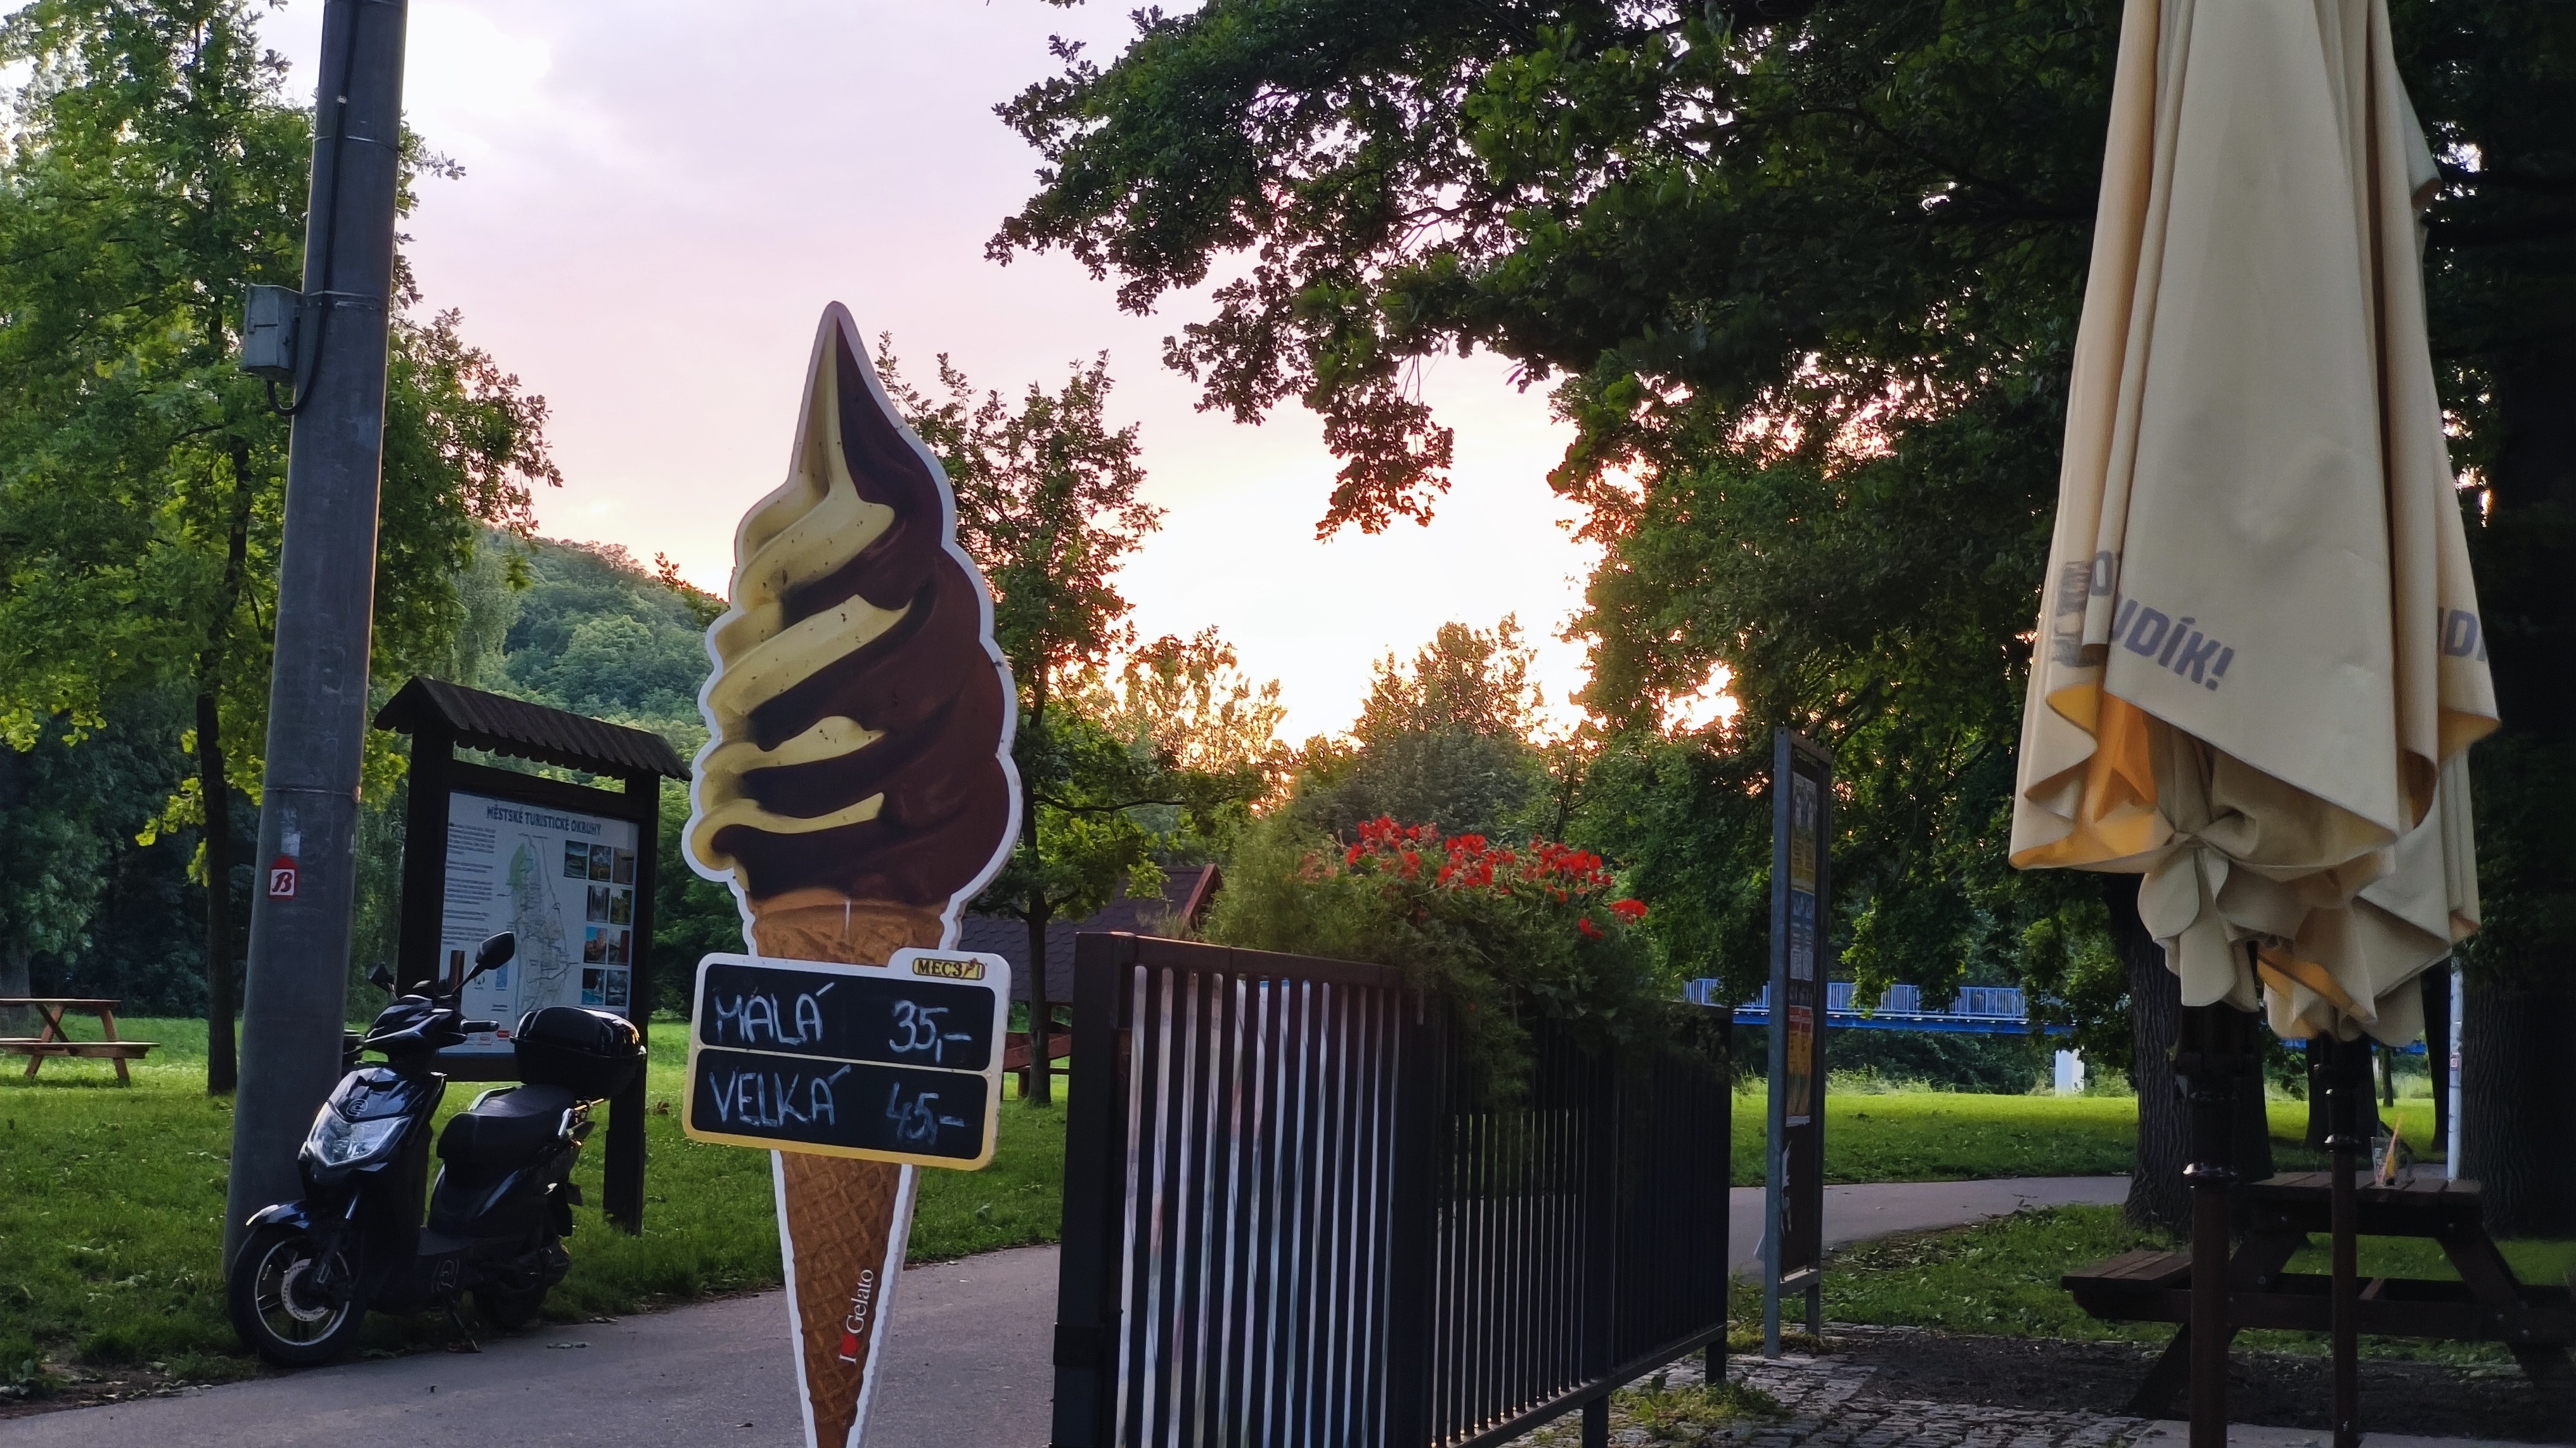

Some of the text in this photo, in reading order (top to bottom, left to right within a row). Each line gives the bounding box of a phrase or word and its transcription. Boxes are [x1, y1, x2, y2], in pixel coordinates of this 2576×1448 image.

[487, 803, 523, 824] MĚSTSKÉ
[917, 960, 962, 977] MEC3
[714, 982, 835, 1045] MALÁ
[709, 1064, 851, 1127] VELKÁ
[846, 1269, 873, 1334] Gelato
